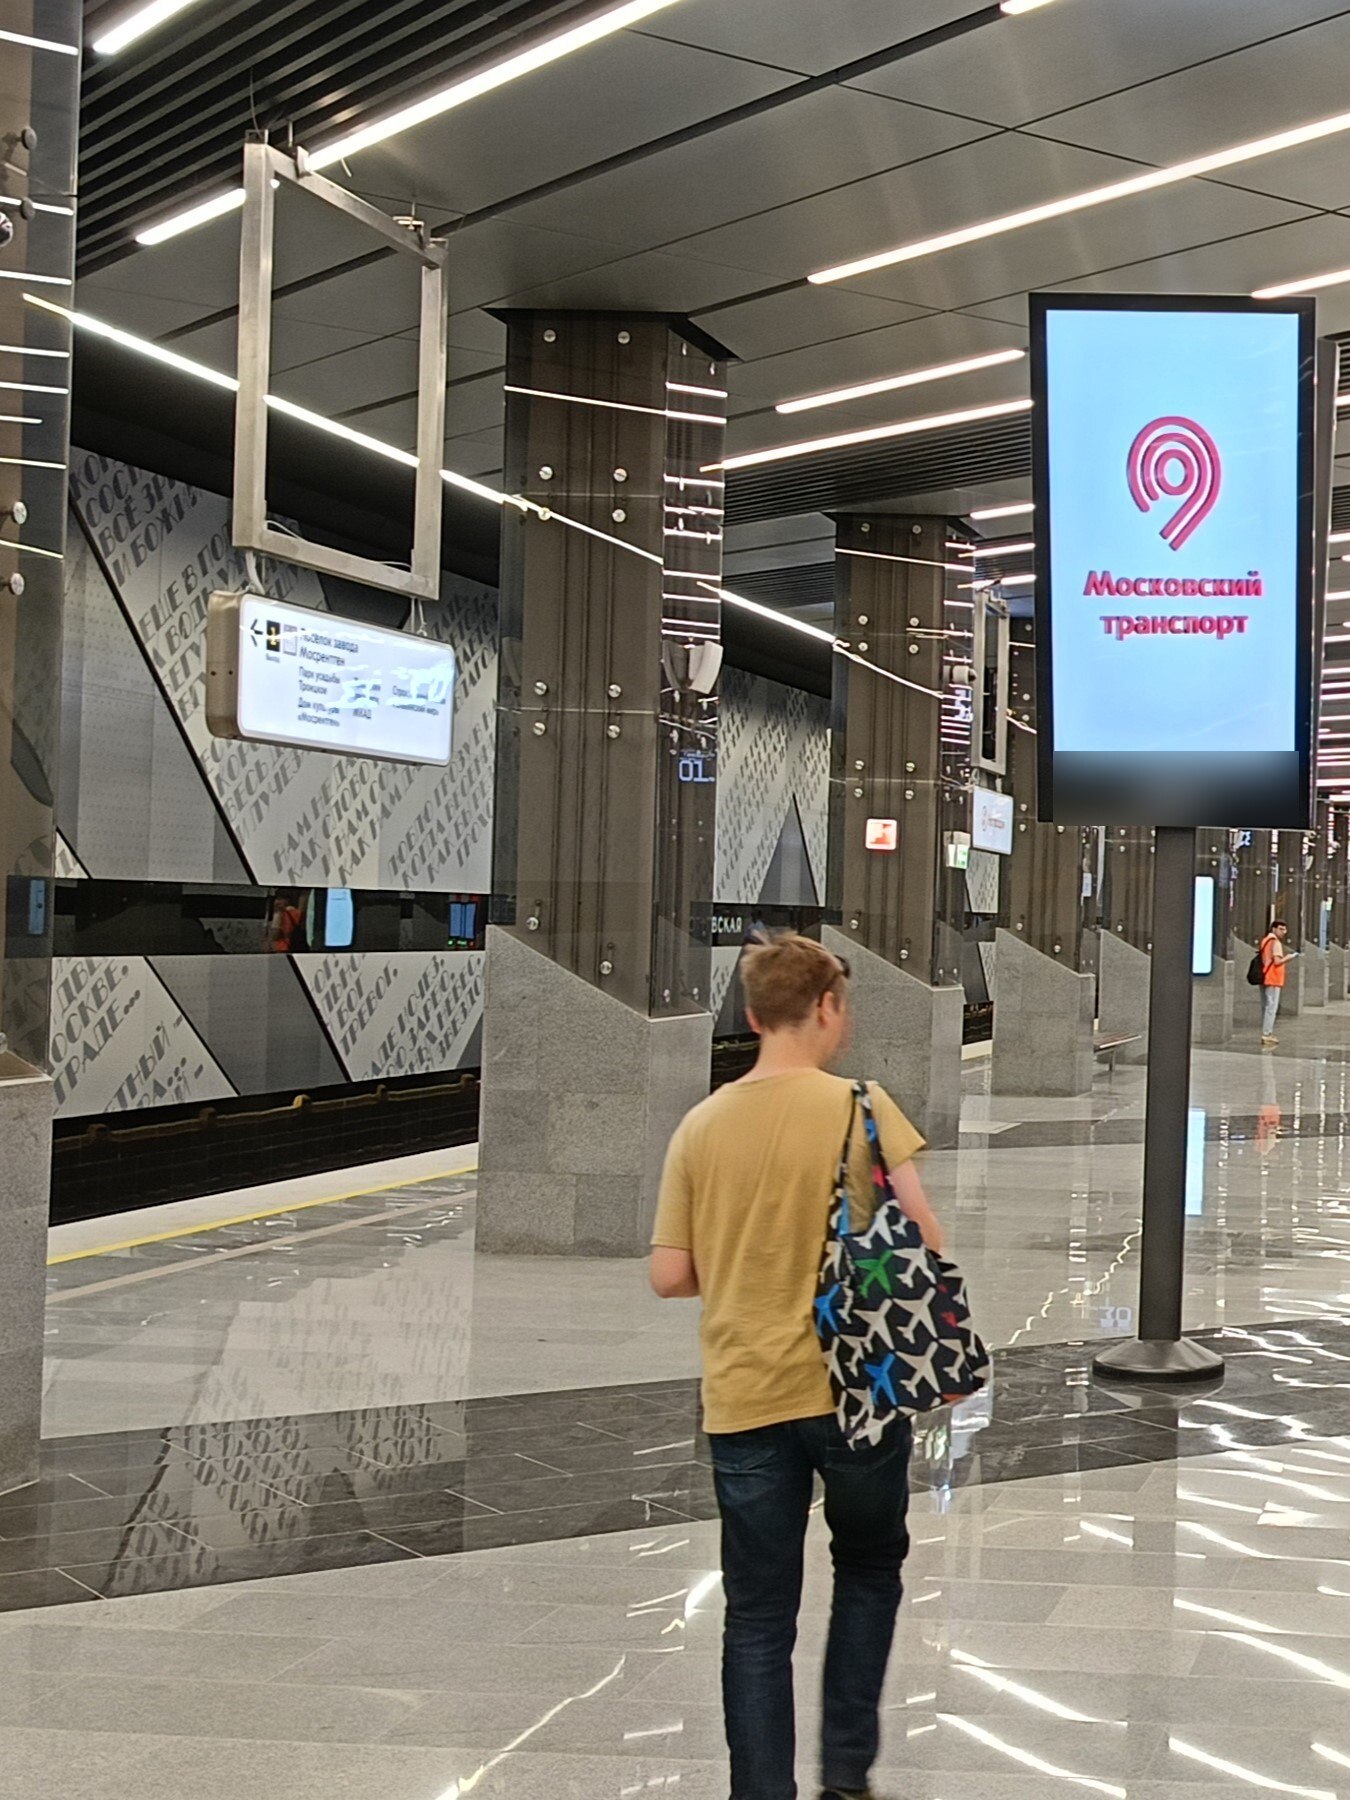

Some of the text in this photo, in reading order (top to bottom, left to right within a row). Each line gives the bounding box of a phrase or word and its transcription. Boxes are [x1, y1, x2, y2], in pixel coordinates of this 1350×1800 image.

[97, 497, 143, 559] ВСЁ
[1083, 570, 1263, 597] Московский
[1099, 615, 1250, 641] транспорт
[273, 812, 313, 875] НАМ
[334, 797, 371, 859] НАМ
[337, 836, 371, 888] КАК
[711, 916, 743, 934] ВСКАЯ
